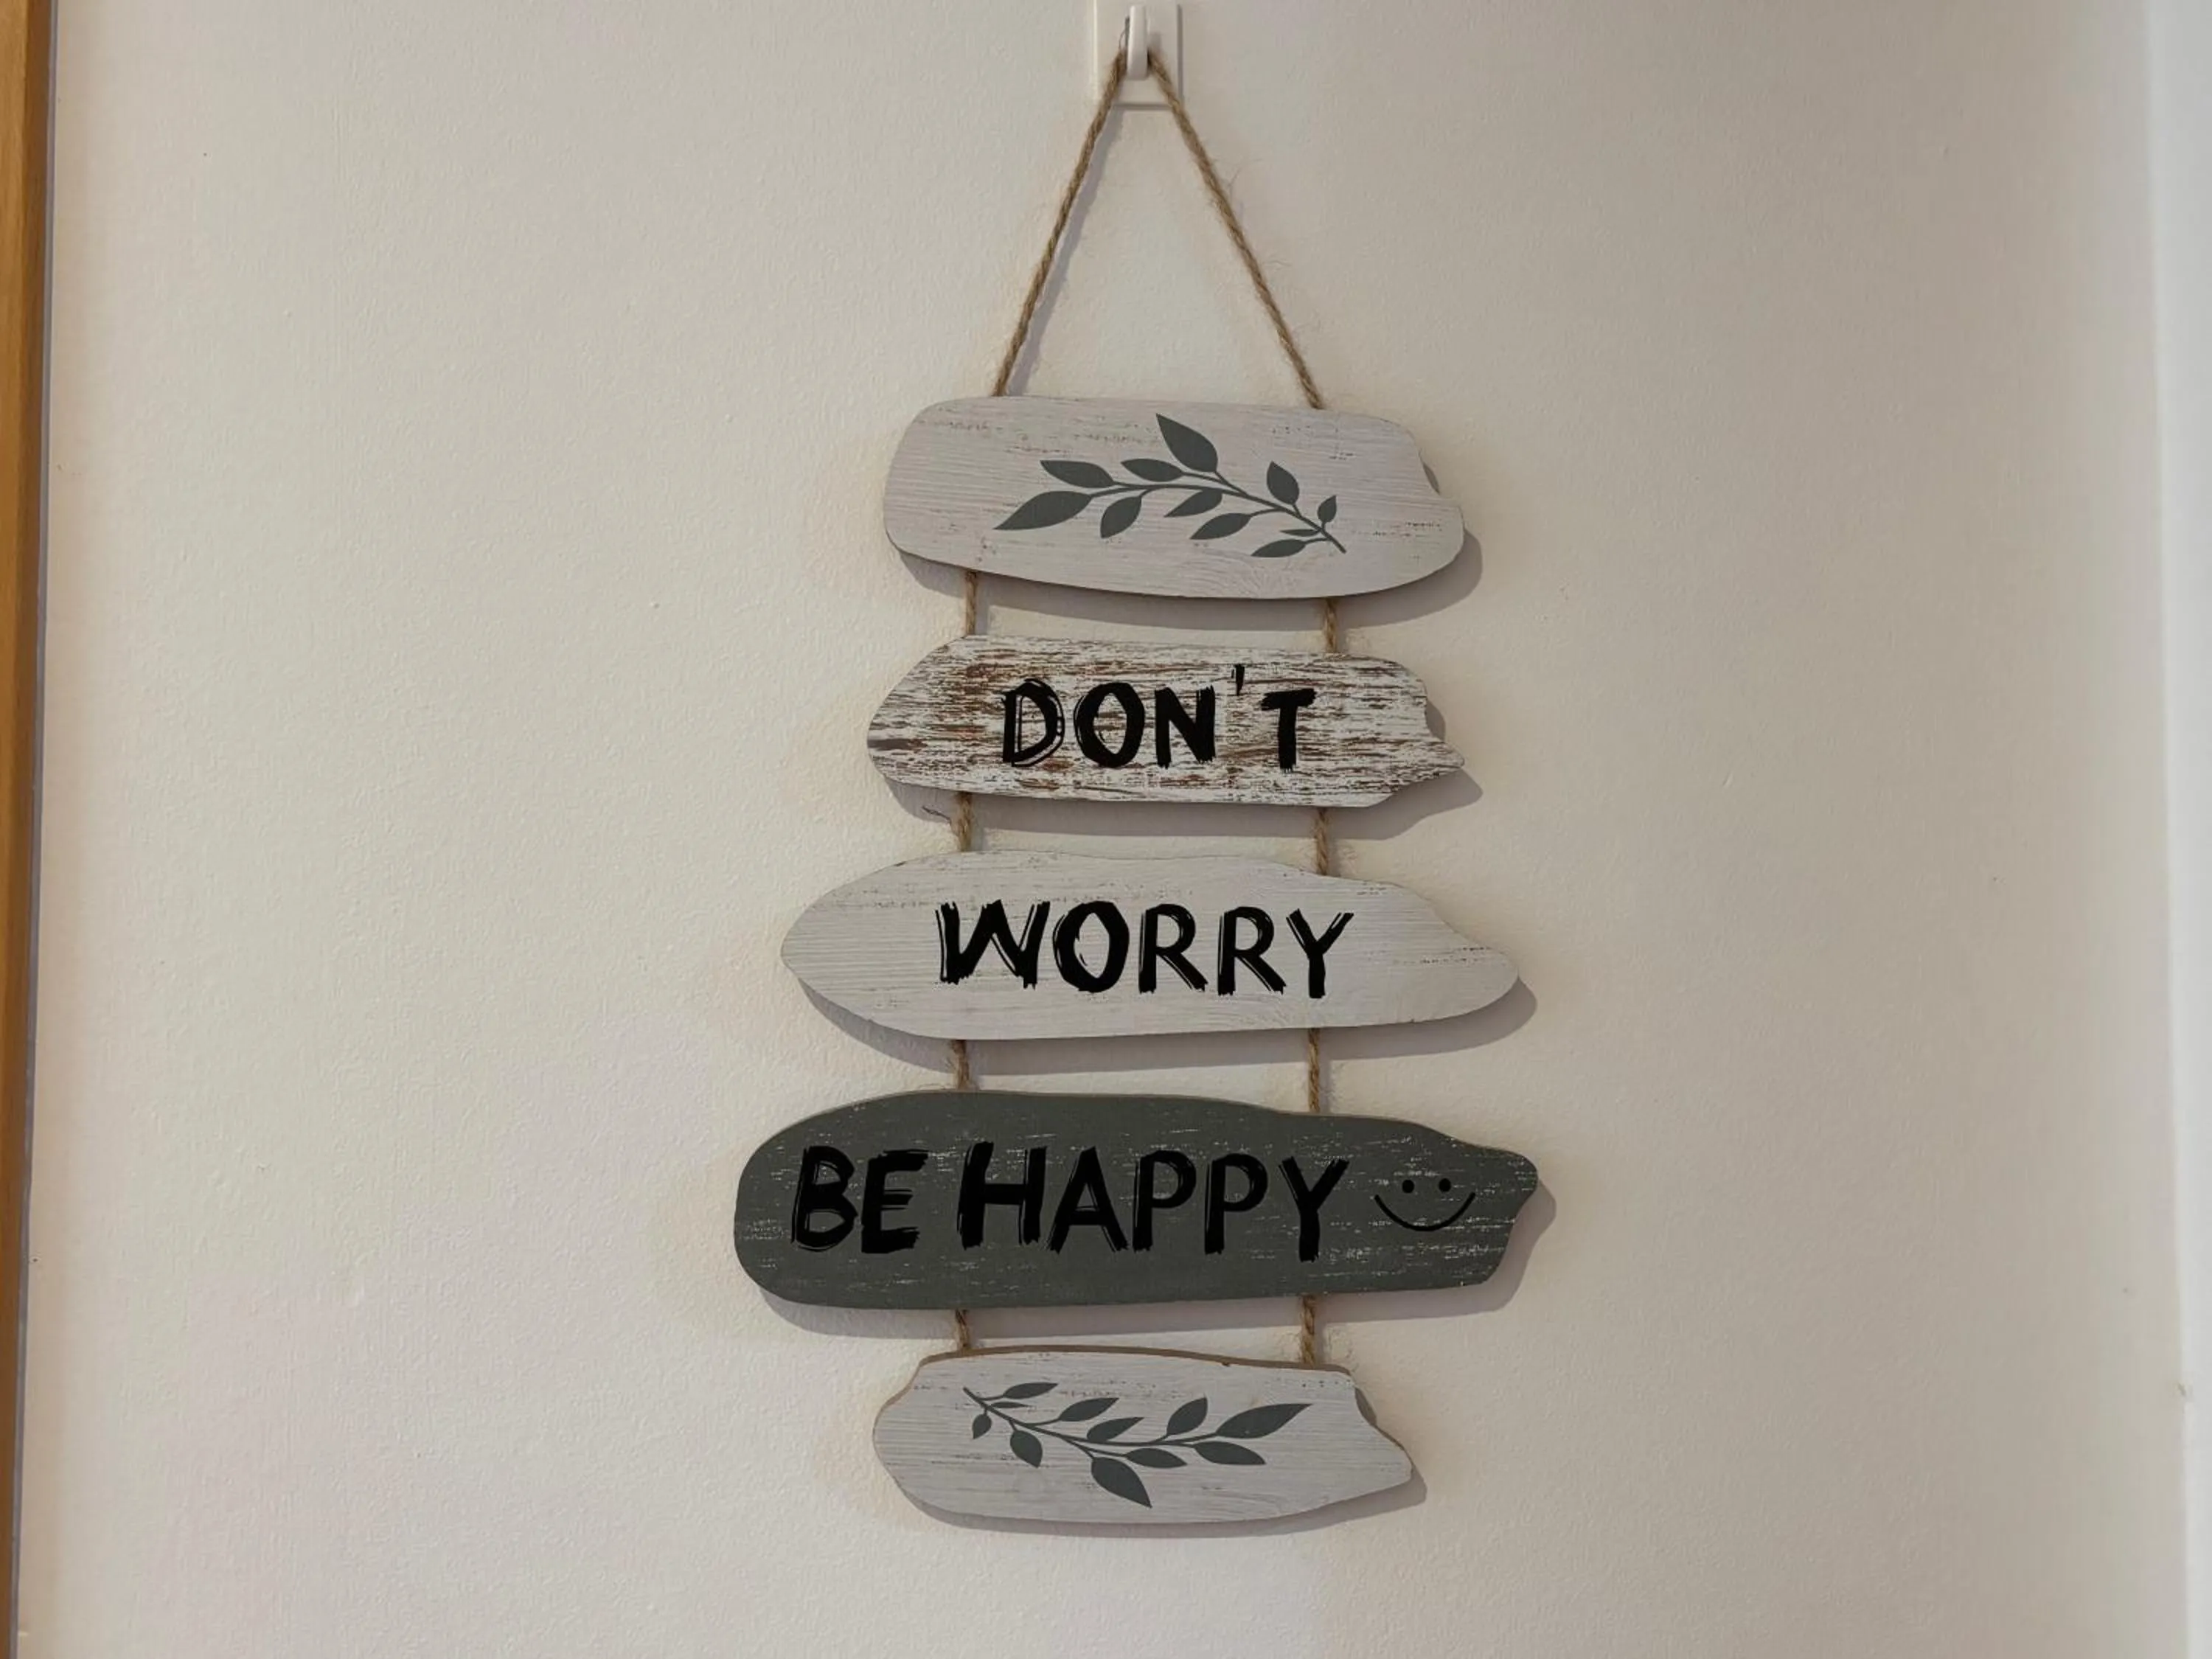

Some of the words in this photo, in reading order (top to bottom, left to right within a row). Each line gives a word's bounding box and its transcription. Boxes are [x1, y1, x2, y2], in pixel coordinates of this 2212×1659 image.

[1001, 664, 1315, 773] DON'T
[935, 899, 1355, 999] WORRY
[790, 1145, 931, 1255] BE
[956, 1140, 1351, 1263] HAPPY
